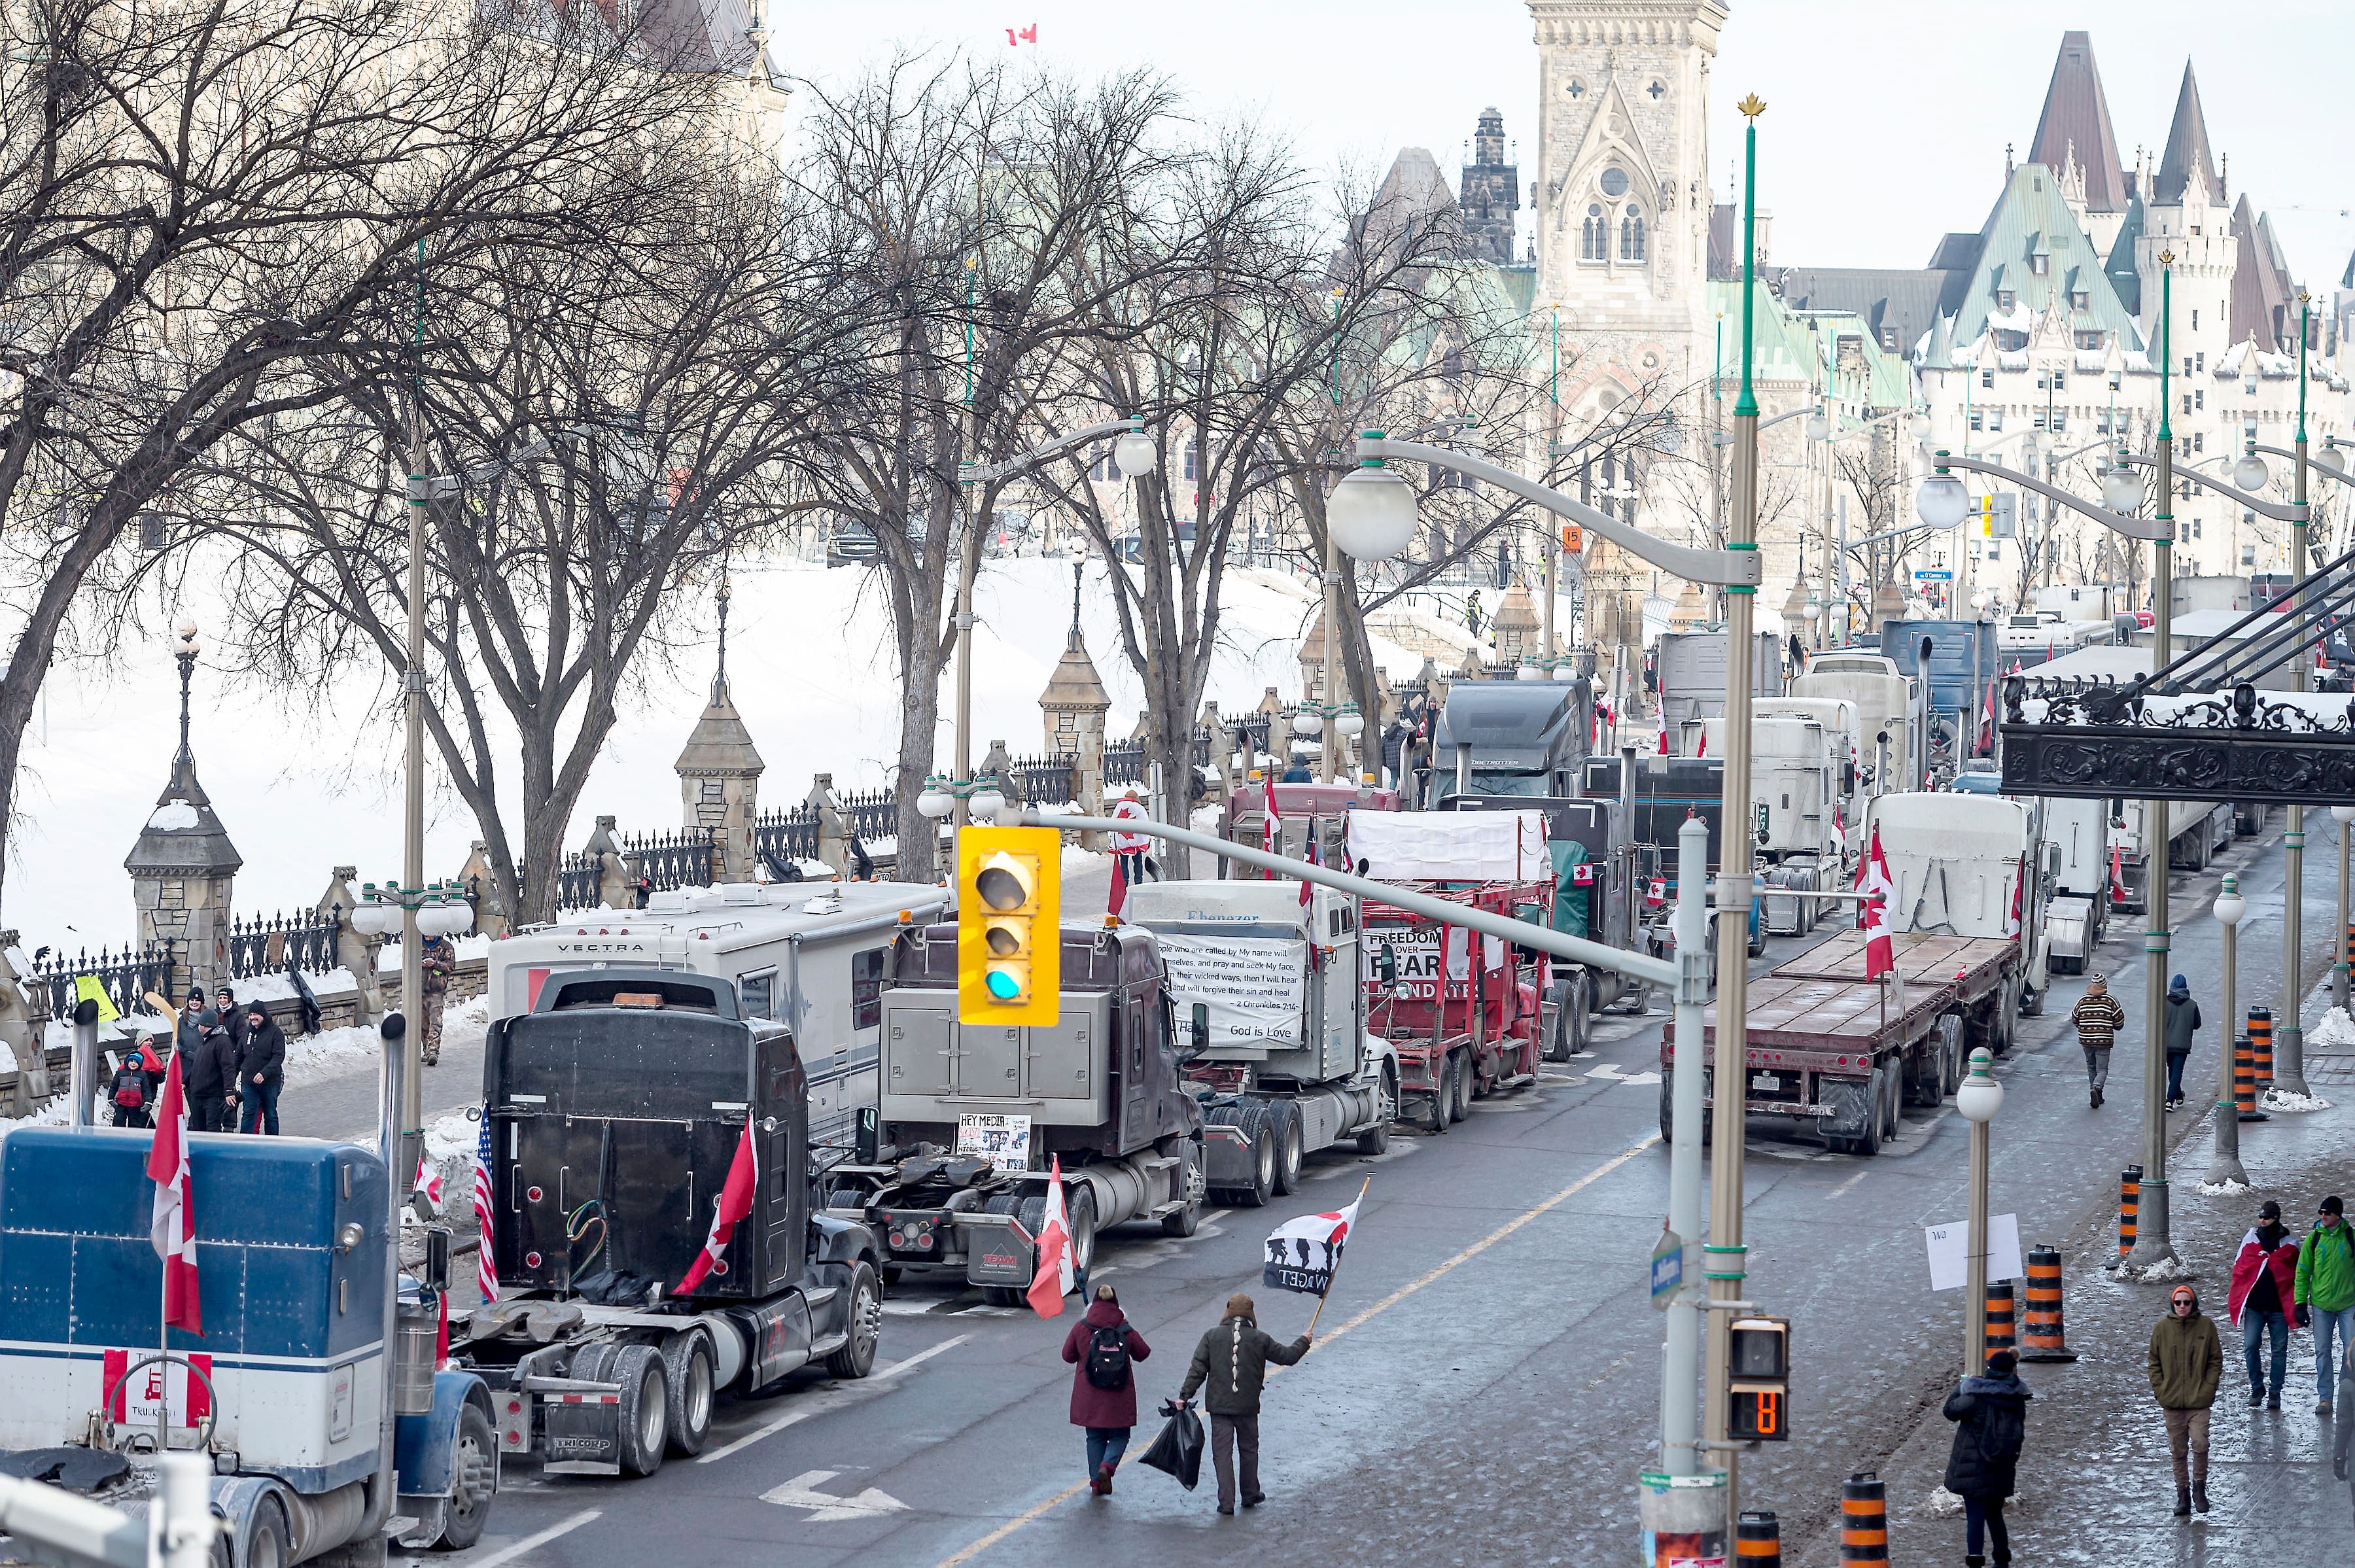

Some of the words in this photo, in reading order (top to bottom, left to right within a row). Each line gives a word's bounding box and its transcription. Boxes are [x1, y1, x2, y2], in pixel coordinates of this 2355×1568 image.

[1567, 531, 1578, 542] 15
[1370, 932, 1441, 945] FREEDOM
[1202, 986, 1226, 994] forgive
[1180, 1022, 1193, 1032] Ha
[1231, 1026, 1251, 1036] God
[1255, 1026, 1263, 1036] is
[1267, 1028, 1291, 1037] Love
[961, 1115, 977, 1126] HEY
[979, 1115, 1005, 1127] MEDIA
[983, 1254, 1017, 1265] TEAM
